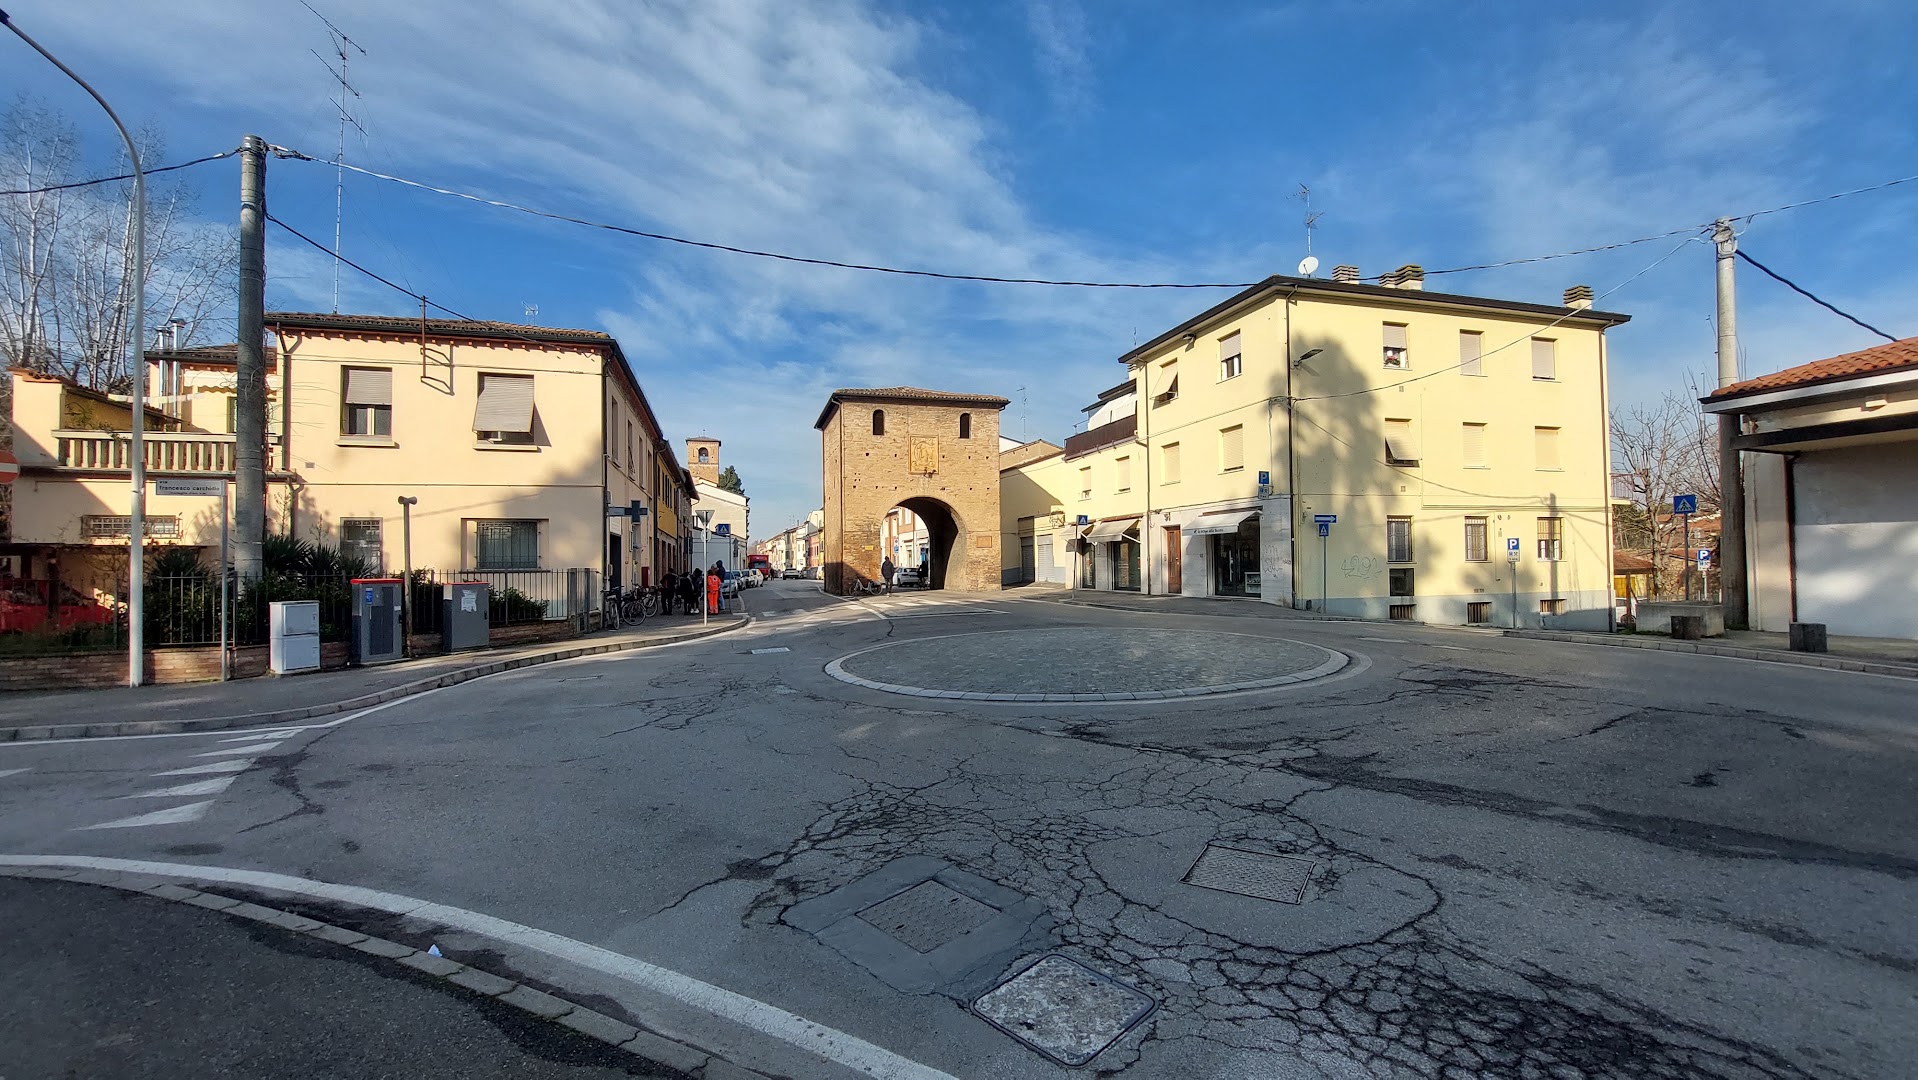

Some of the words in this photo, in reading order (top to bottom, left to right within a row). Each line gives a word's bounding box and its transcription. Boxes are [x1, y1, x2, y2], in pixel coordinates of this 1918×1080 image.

[1260, 473, 1268, 483] P
[1509, 539, 1518, 549] P
[1699, 550, 1709, 560] P
